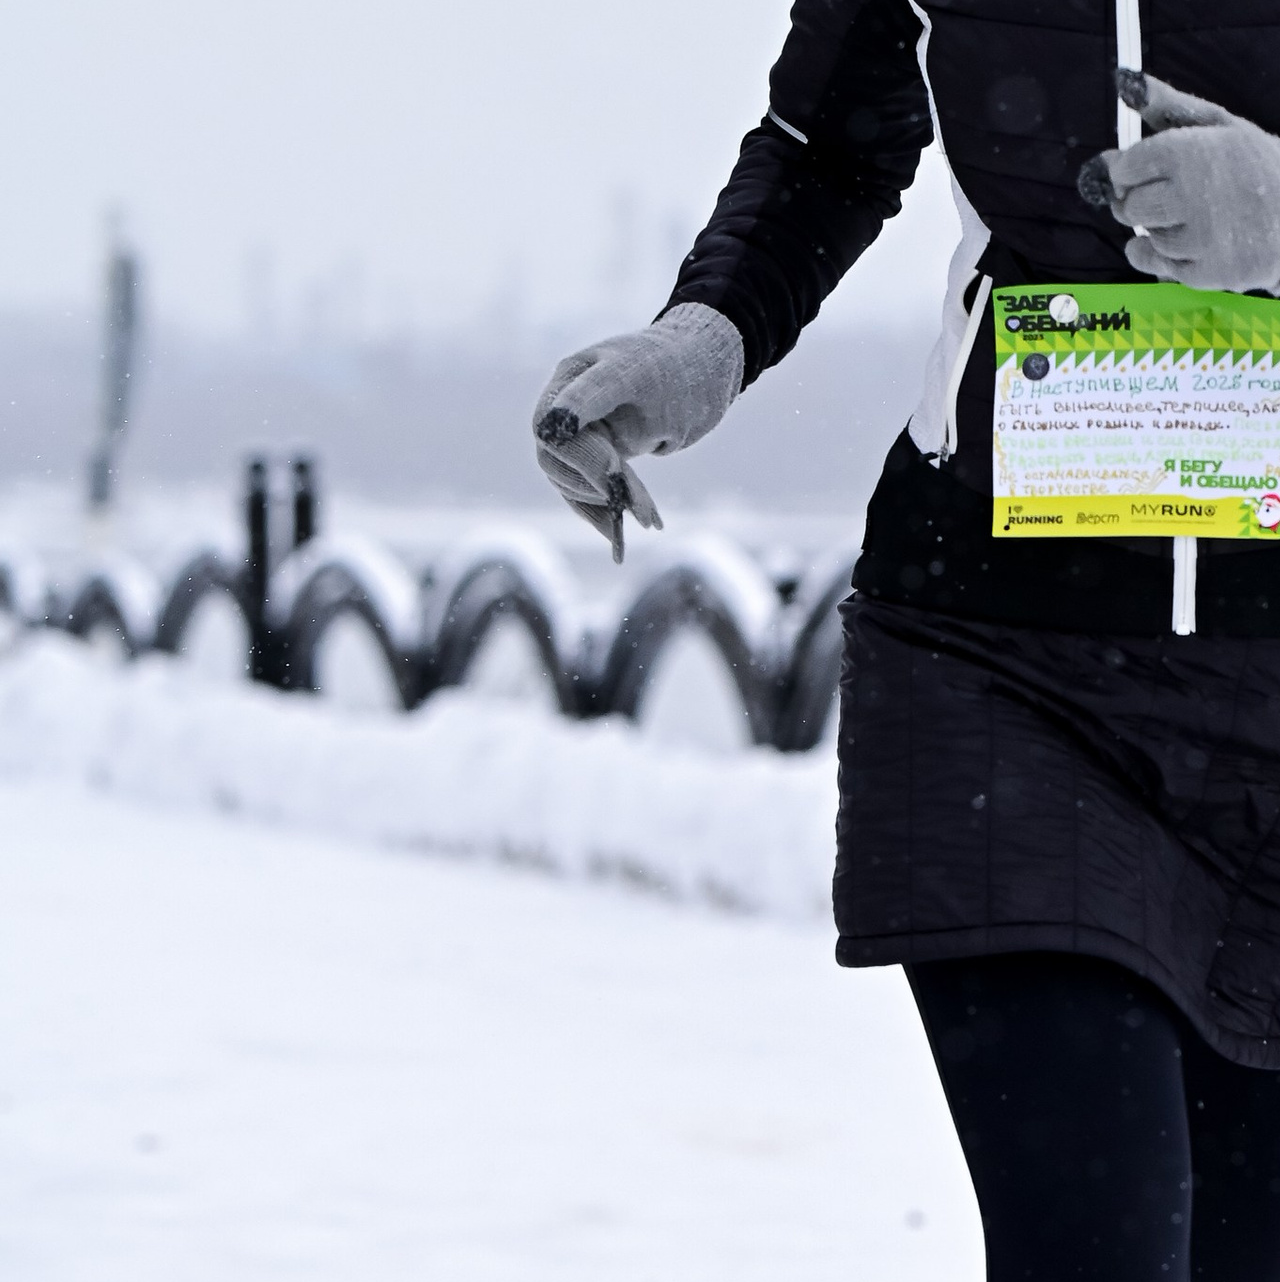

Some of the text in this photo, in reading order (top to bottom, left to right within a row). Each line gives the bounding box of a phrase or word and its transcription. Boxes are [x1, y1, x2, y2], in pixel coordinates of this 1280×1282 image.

[1003, 293, 1074, 312] ЗАБ
[1164, 459, 1223, 473] Я БЕГУ
[1180, 475, 1278, 491] И ОБЕЩАЮ
[1008, 516, 1063, 525] RUNNING
